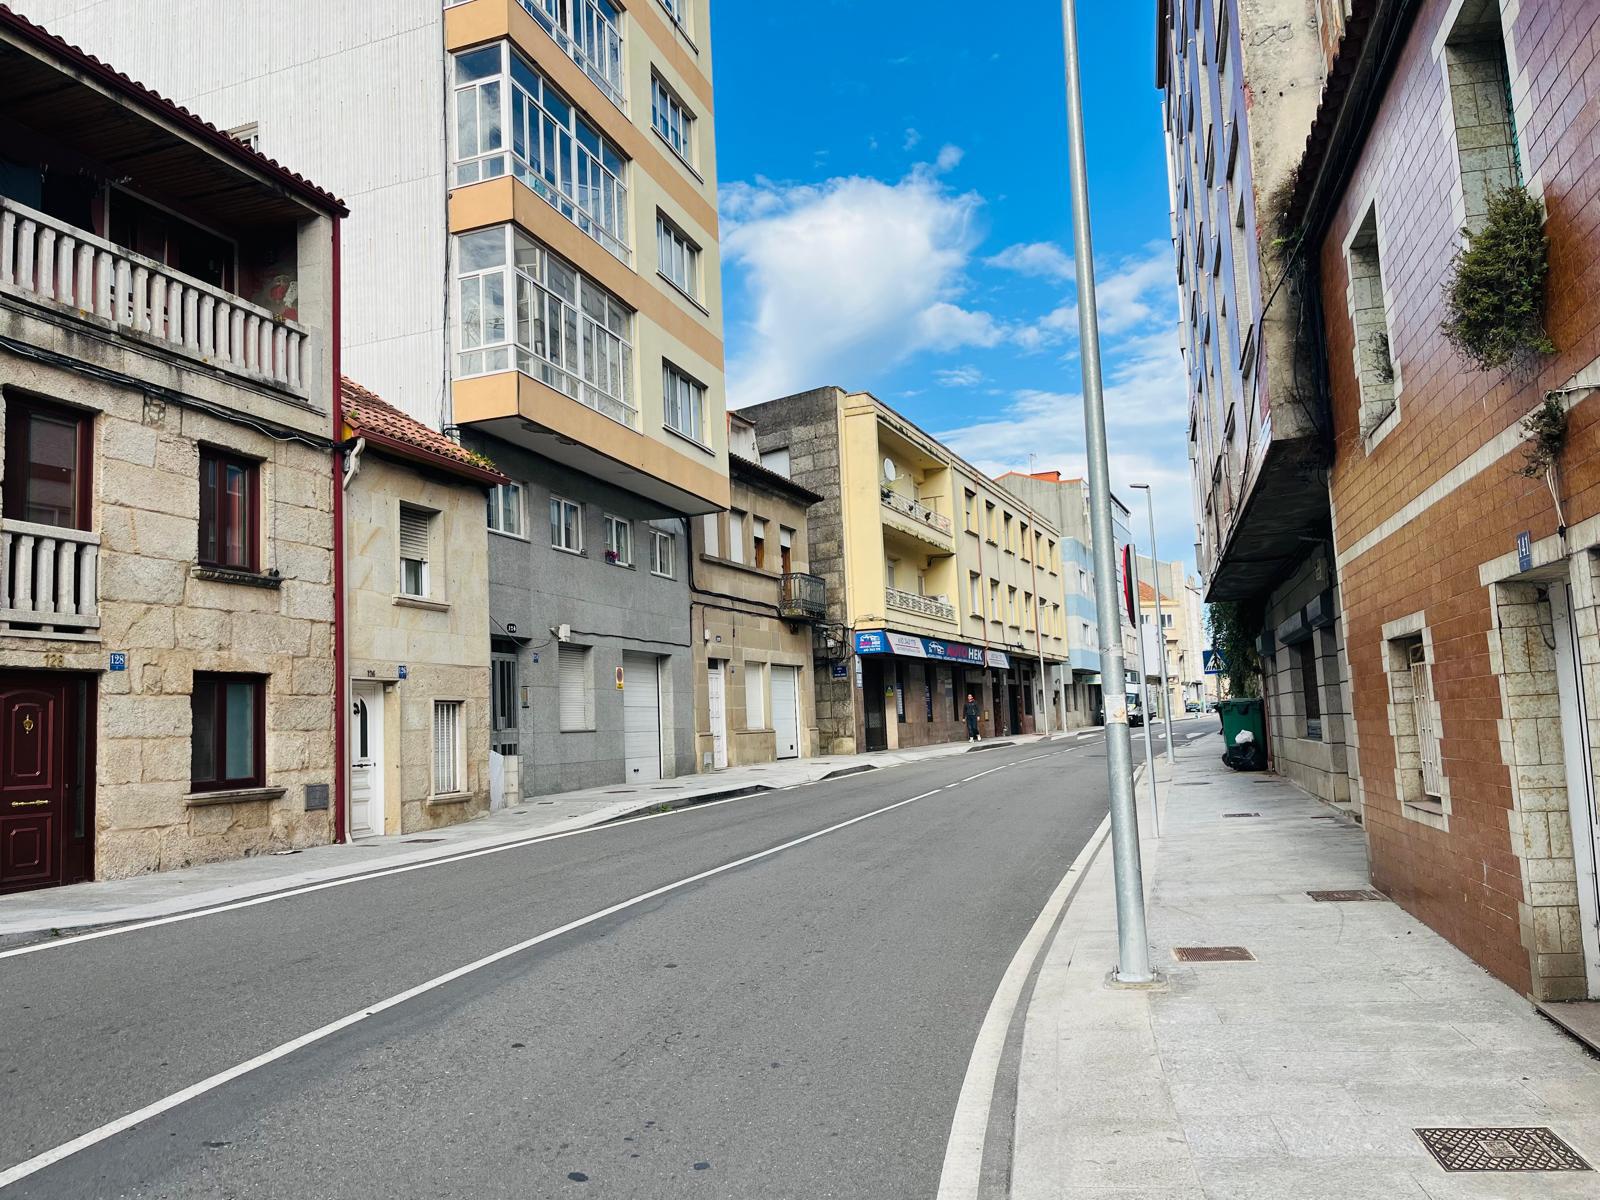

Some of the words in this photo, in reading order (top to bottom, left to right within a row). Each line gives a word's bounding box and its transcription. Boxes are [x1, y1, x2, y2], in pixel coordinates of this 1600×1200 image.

[1517, 536, 1529, 557] 141
[44, 653, 64, 667] 128
[111, 654, 124, 665] 128
[947, 644, 968, 657] AUTO
[968, 648, 983, 661] HEK
